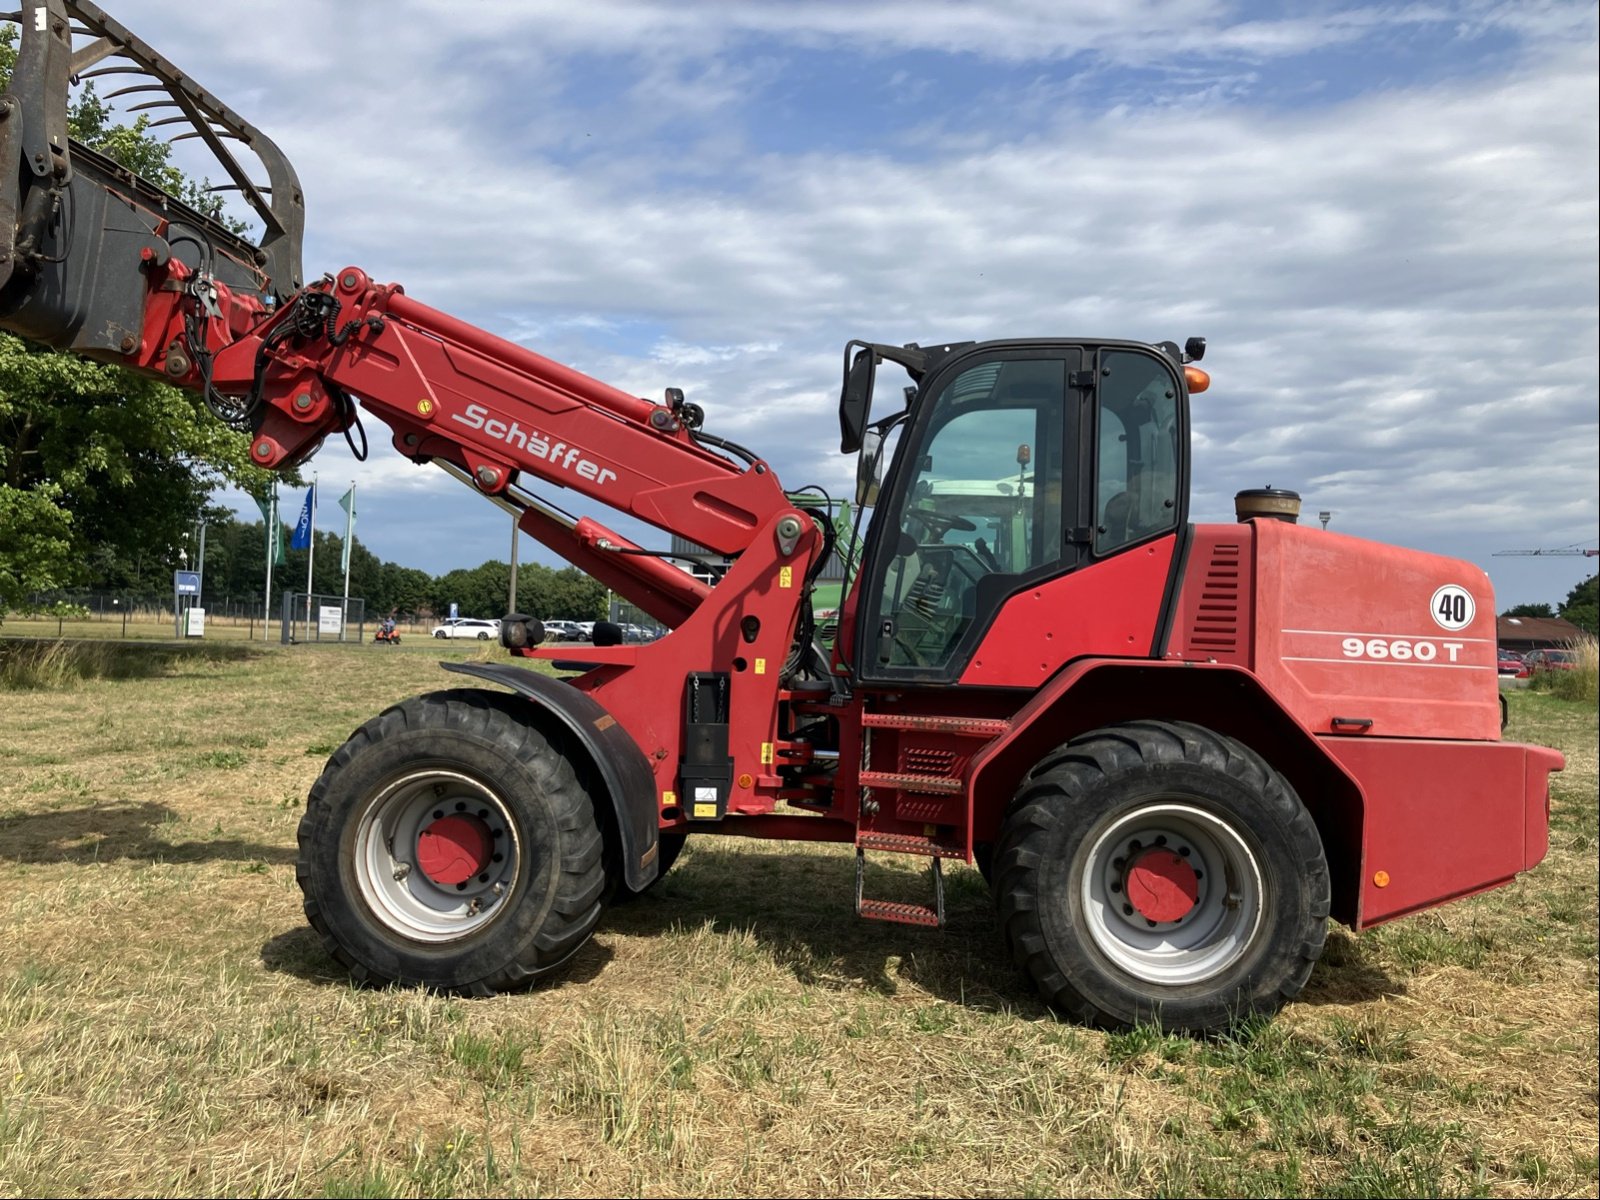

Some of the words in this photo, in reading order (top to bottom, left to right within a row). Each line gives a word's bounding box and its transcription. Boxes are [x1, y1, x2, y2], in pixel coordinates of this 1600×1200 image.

[451, 404, 617, 485] Schäffer
[1438, 594, 1466, 623] 40
[1341, 638, 1437, 661] 9660
[1443, 643, 1464, 662] T
